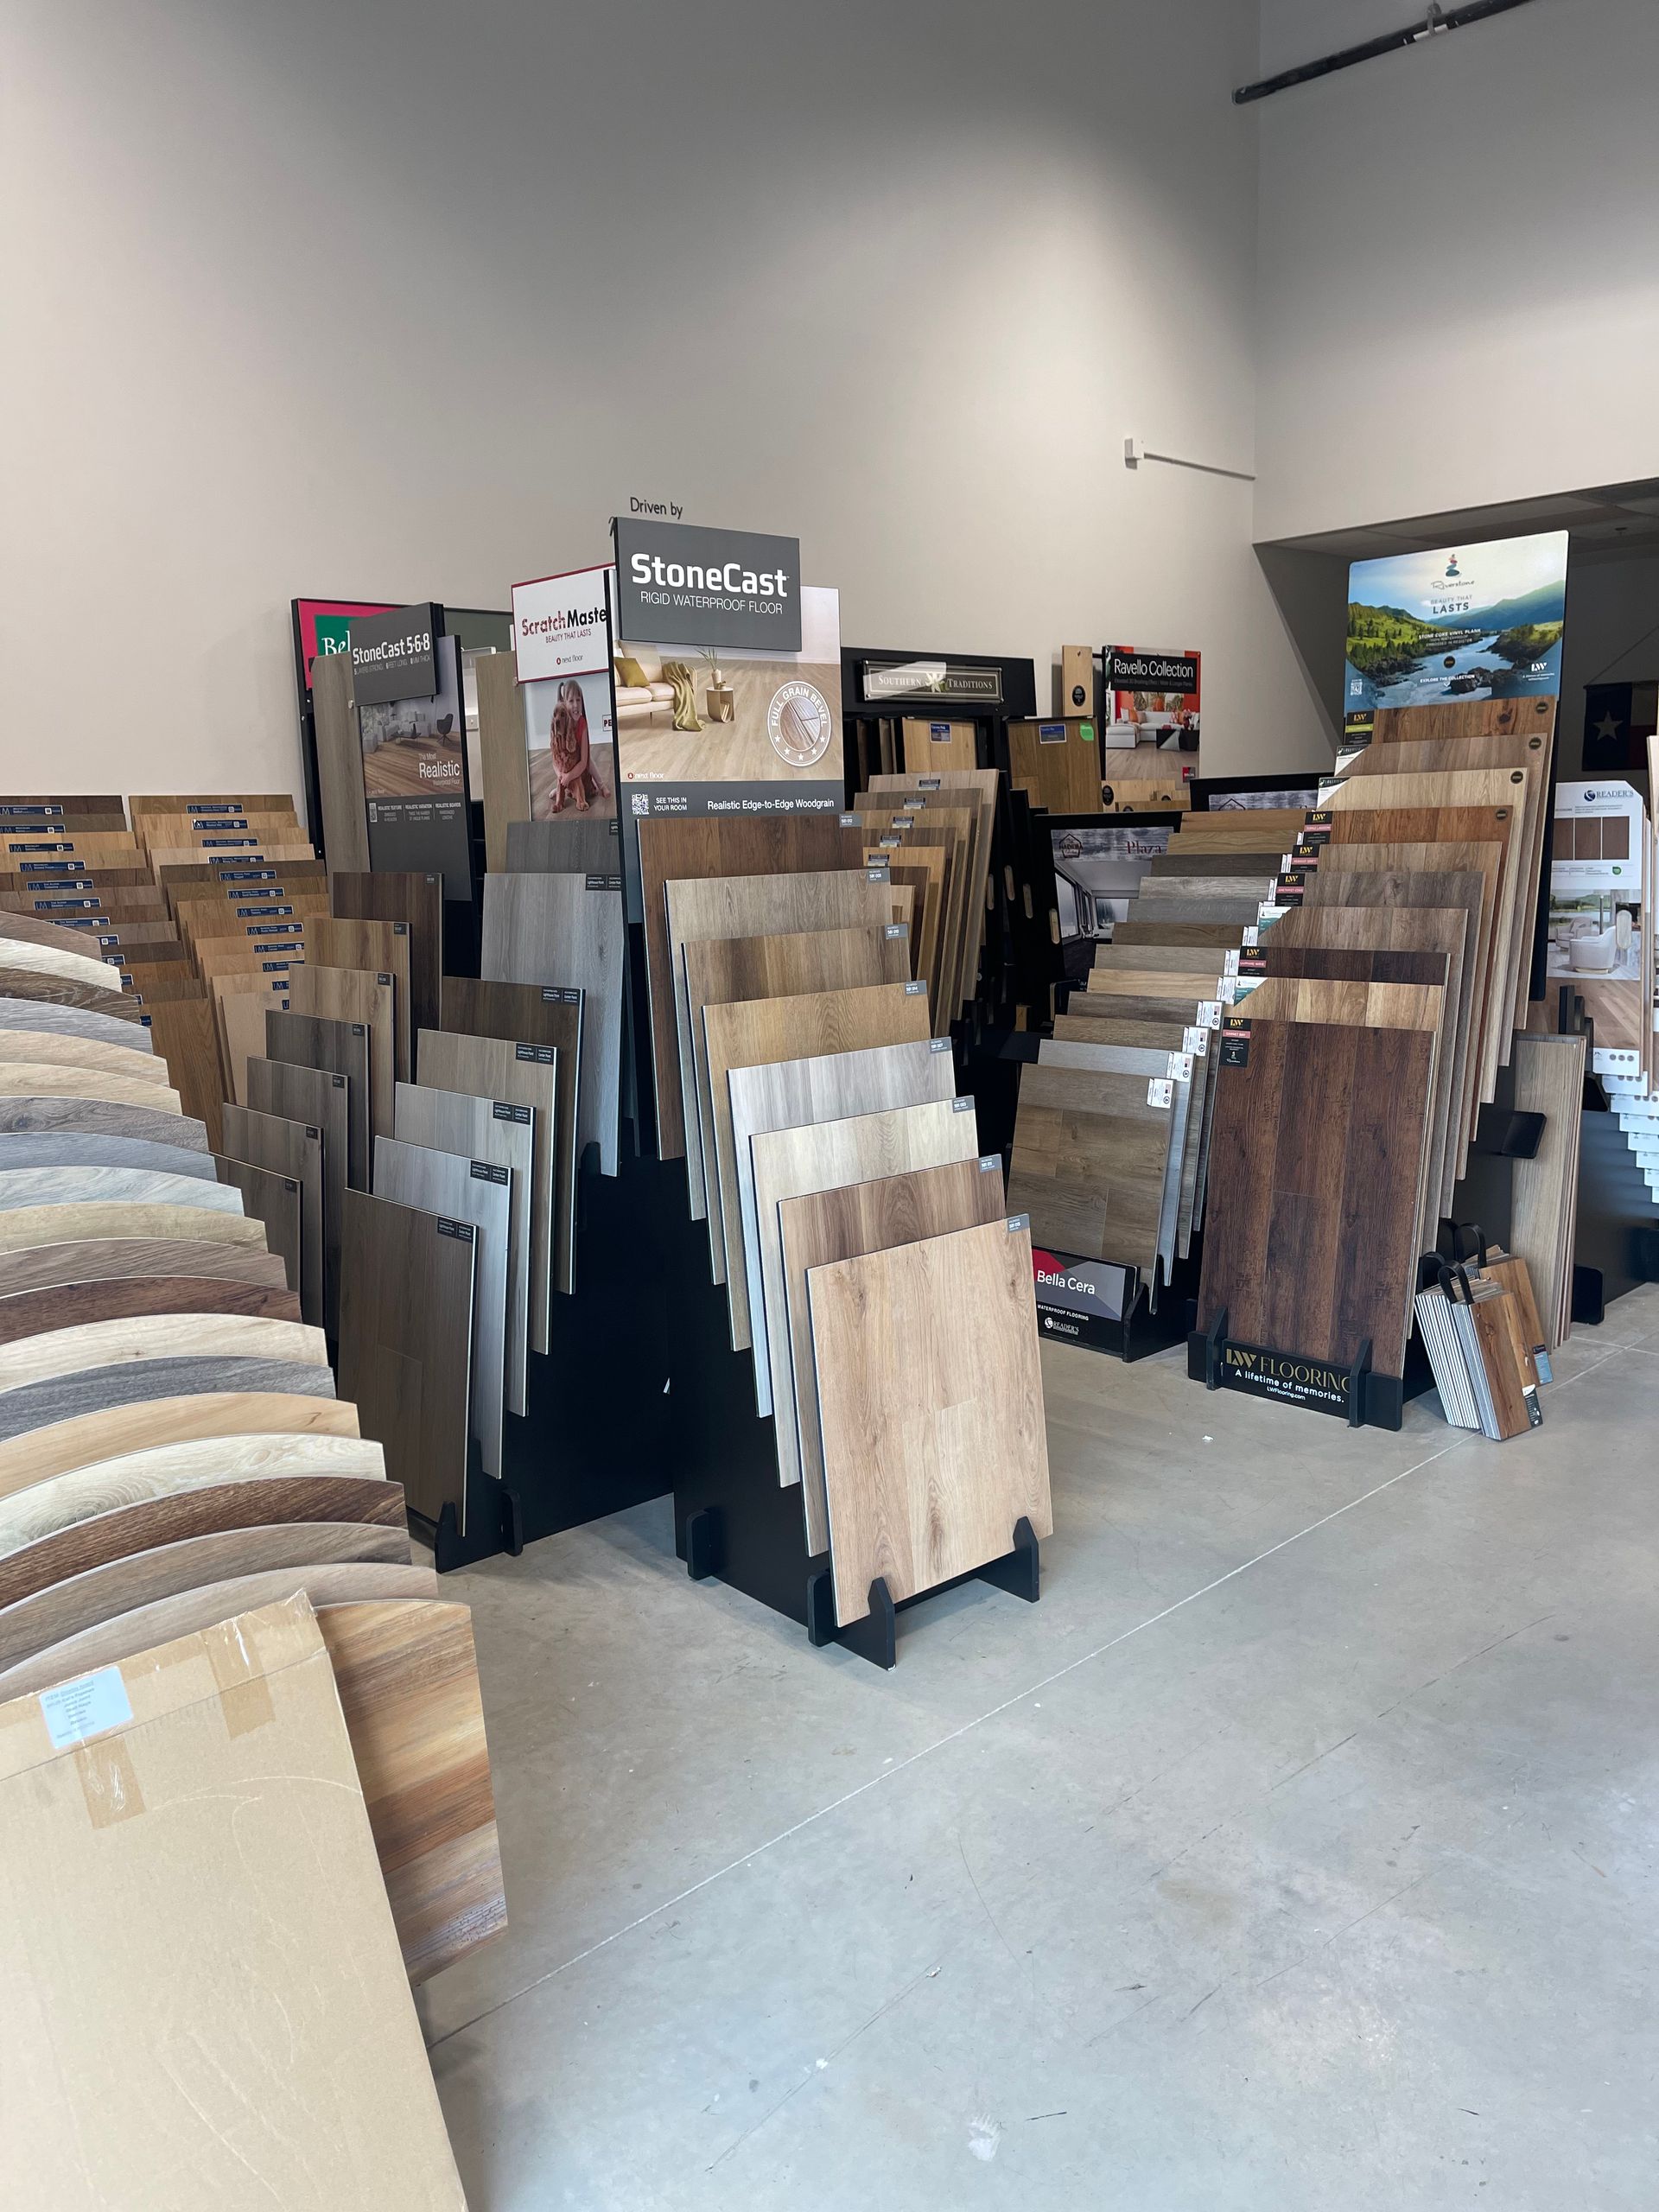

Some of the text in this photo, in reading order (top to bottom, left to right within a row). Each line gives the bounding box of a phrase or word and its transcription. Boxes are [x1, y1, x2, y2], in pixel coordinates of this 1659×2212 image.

[630, 497, 683, 519] Driven by
[631, 553, 788, 597] StoneCast
[640, 591, 783, 614] RIGID WATERPROOF FLOOR
[1433, 602, 1470, 614] LASTS
[545, 628, 592, 643] BEAUTY THAT LASTS
[353, 639, 405, 665] StoneCast
[1114, 658, 1193, 677] Ravello Collection
[878, 675, 993, 690] SOUTHERN TRADITIONS
[772, 686, 828, 727] FULL GRAIN BEVEL
[418, 760, 460, 778] Realistic
[1596, 790, 1634, 798] READER'S
[708, 798, 835, 810] Realistic Edge-to-Edge Woodgrain
[1126, 841, 1162, 855] Plaza
[1037, 1269, 1096, 1294] Bella Cera
[1037, 1304, 1090, 1321] WATERPROOF FLOORING
[1226, 1348, 1257, 1369] LW
[1235, 1369, 1243, 1377] A
[1245, 1370, 1279, 1386] lifetime
[1295, 1385, 1344, 1402] memories.
[1267, 1386, 1306, 1400] LWFlooring.com
